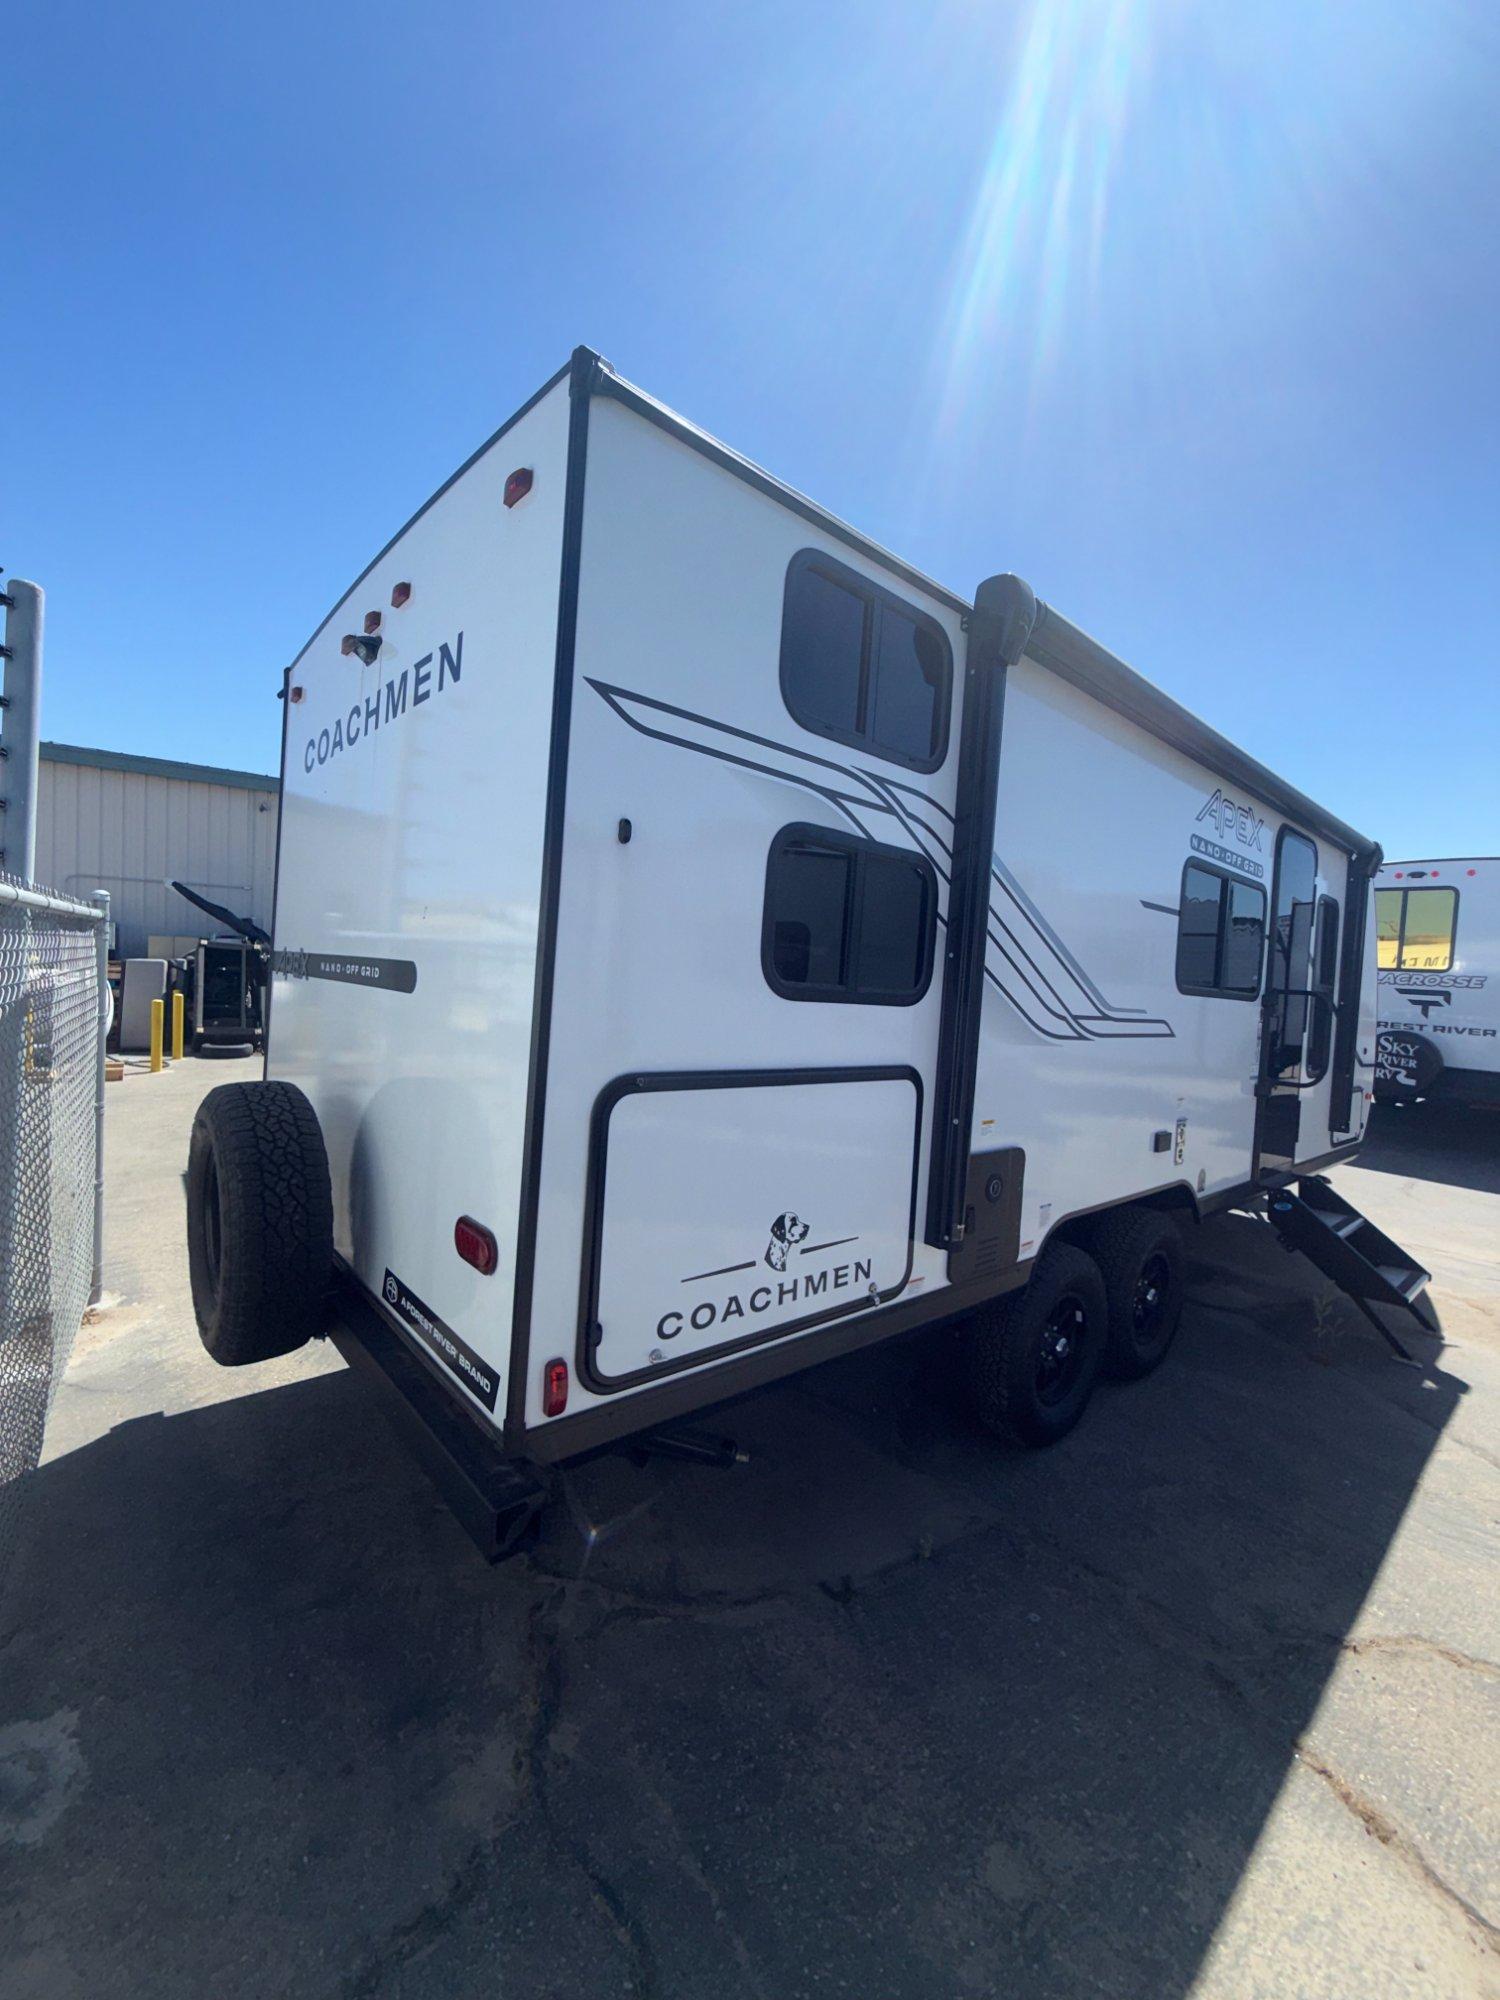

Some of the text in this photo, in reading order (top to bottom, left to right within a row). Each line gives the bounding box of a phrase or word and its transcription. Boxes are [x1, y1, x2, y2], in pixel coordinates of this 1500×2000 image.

[304, 631, 464, 774] COACHMEN
[1195, 789, 1264, 852] APEX
[1243, 860, 1264, 876] GRID
[360, 967, 380, 978] GRID
[1376, 1021, 1497, 1037] REST RIVER
[1378, 1035, 1420, 1056] SKY
[1377, 1053, 1417, 1068] RIVER
[1375, 1068, 1394, 1080] RV
[656, 1258, 872, 1340] COACHMEN
[401, 1297, 491, 1394] A FOREST RIVER BRAND
